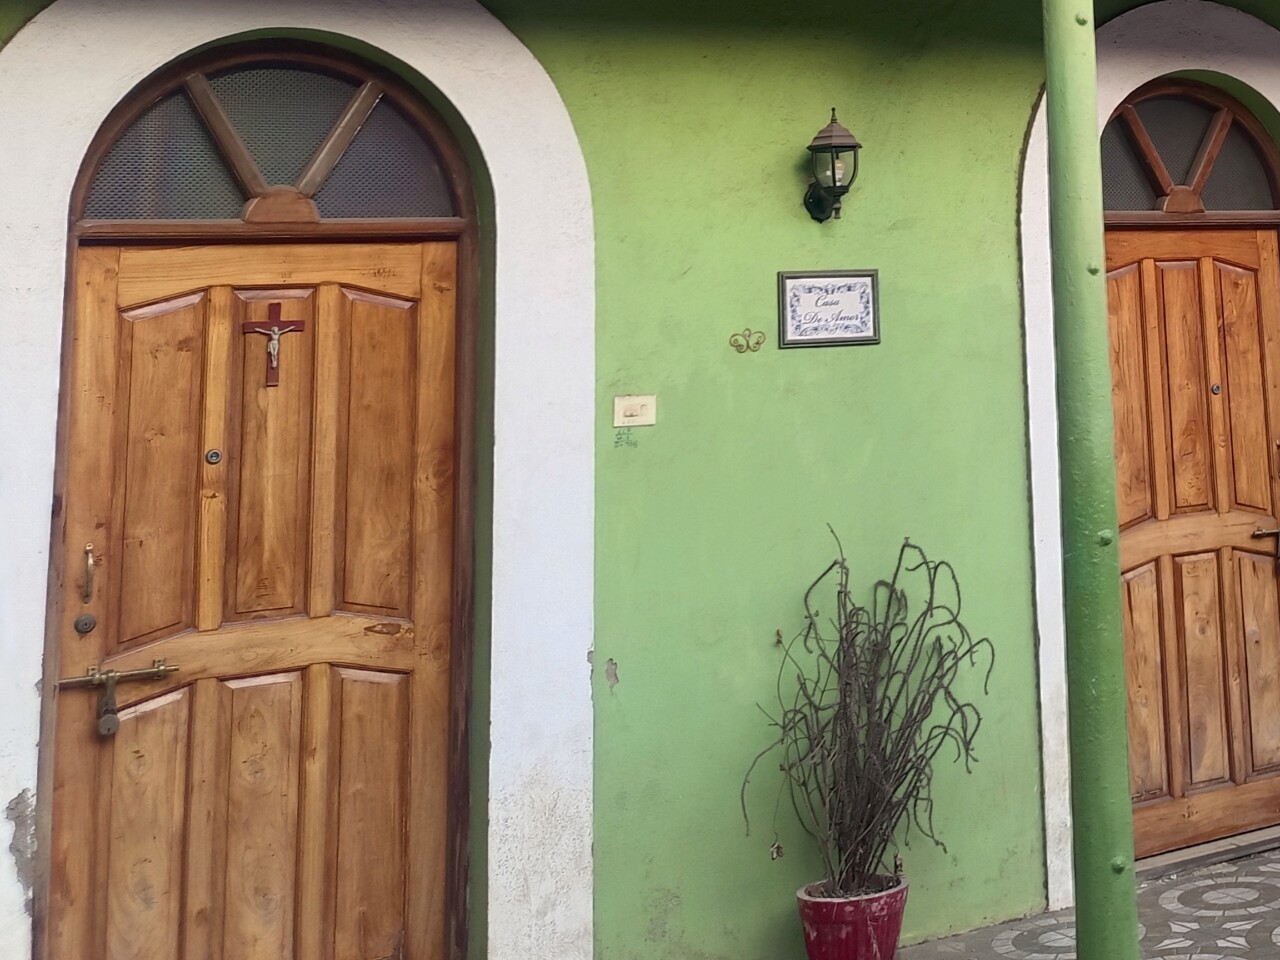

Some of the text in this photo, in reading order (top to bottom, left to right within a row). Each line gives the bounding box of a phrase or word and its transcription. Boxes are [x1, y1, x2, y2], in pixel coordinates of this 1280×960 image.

[815, 295, 840, 308] Casa
[802, 309, 859, 324] De Amor
